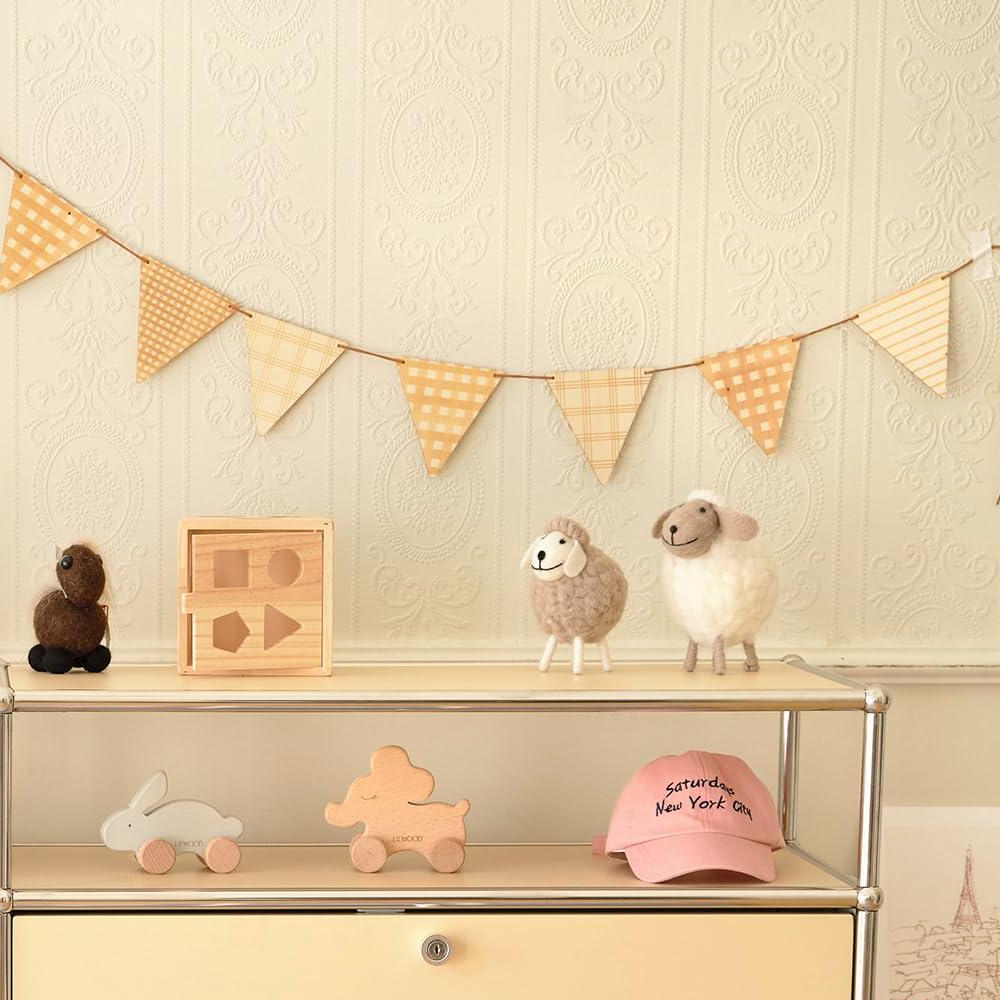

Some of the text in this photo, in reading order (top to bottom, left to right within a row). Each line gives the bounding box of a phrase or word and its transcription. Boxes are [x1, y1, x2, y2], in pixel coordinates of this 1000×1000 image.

[655, 796, 753, 820] New York City
